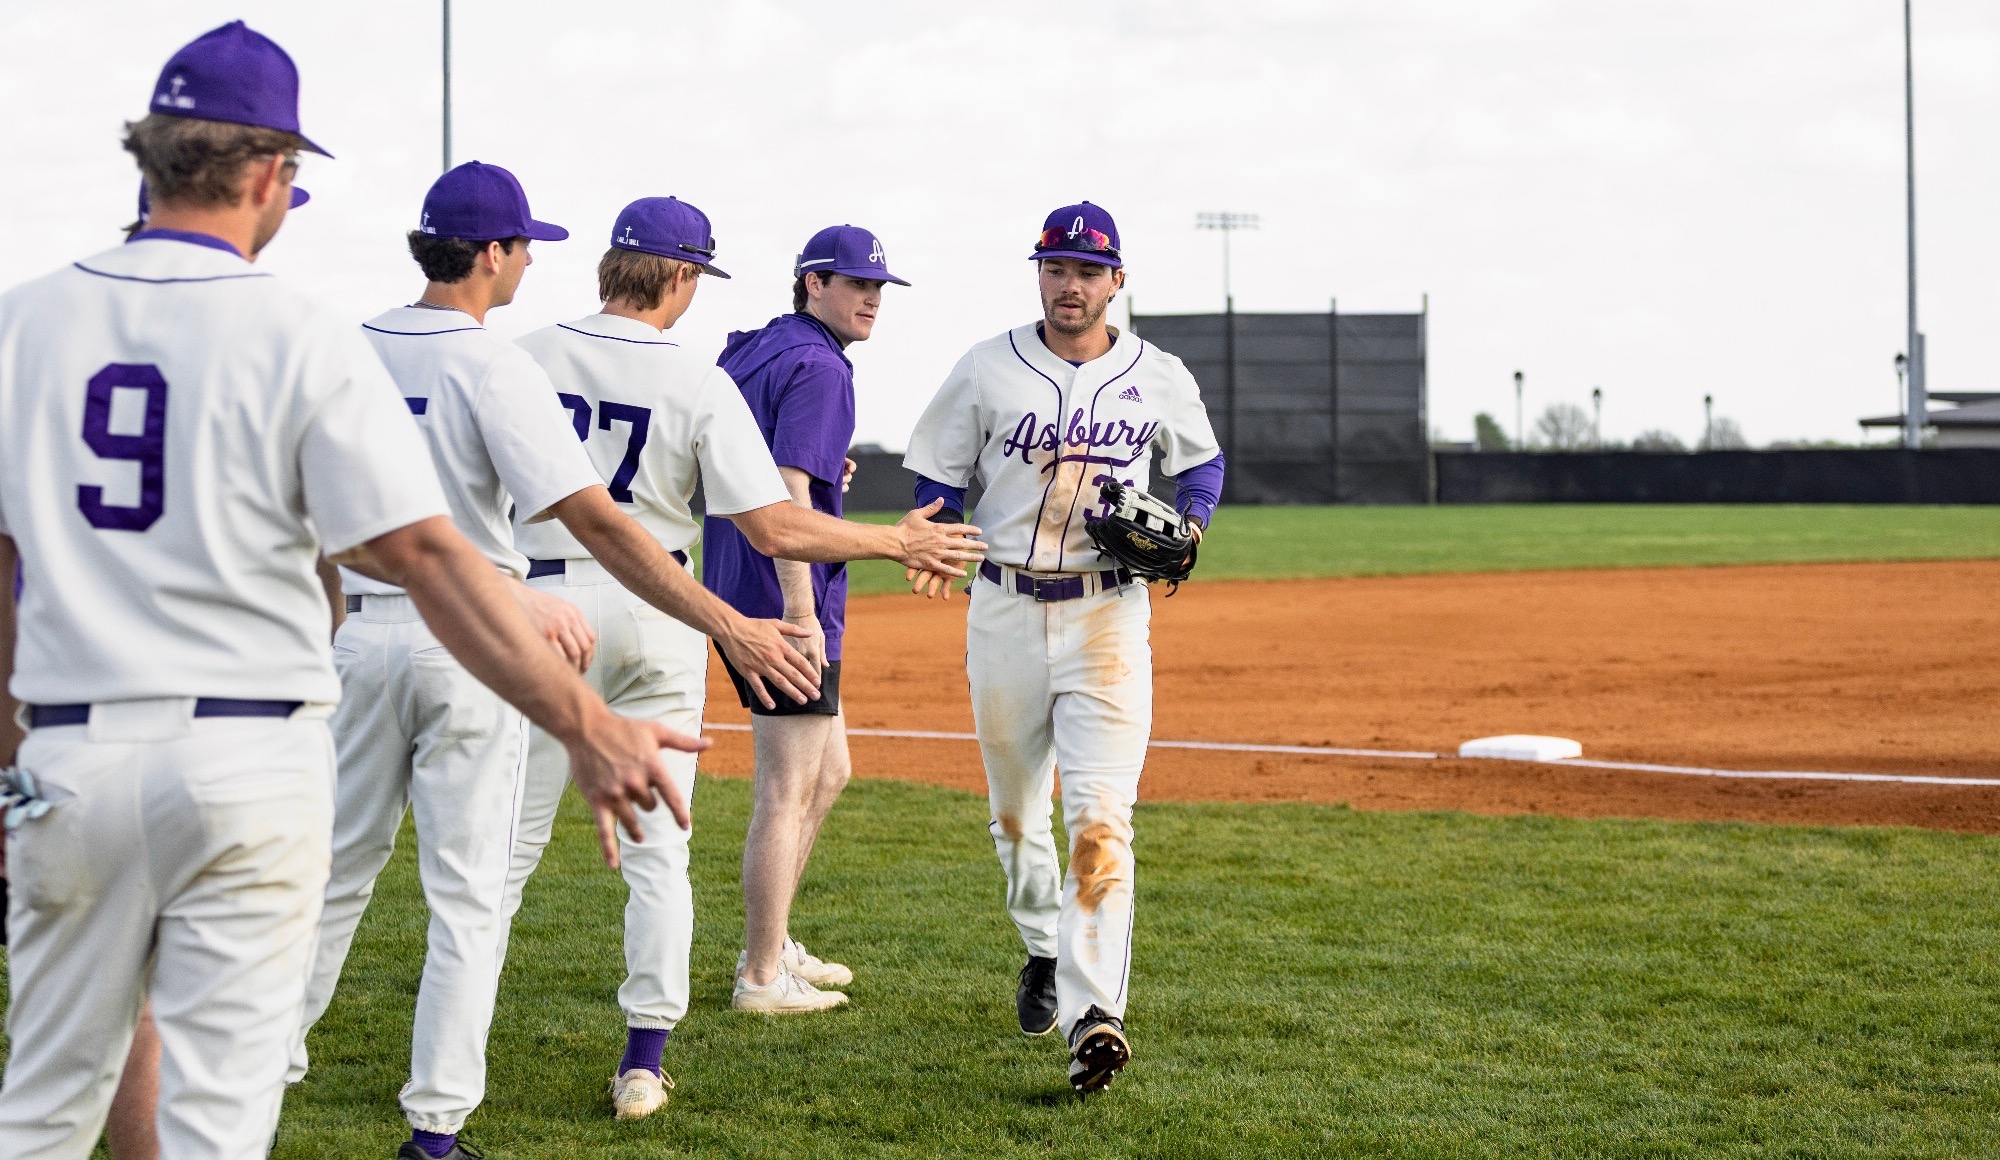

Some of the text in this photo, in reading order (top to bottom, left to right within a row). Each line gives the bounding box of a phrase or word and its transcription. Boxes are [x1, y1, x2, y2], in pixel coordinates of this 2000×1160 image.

[868, 239, 886, 265] A
[1118, 393, 1143, 403] adidas
[77, 362, 168, 532] 9
[1003, 407, 1159, 465] Asbury
[1083, 474, 1135, 523] 3
